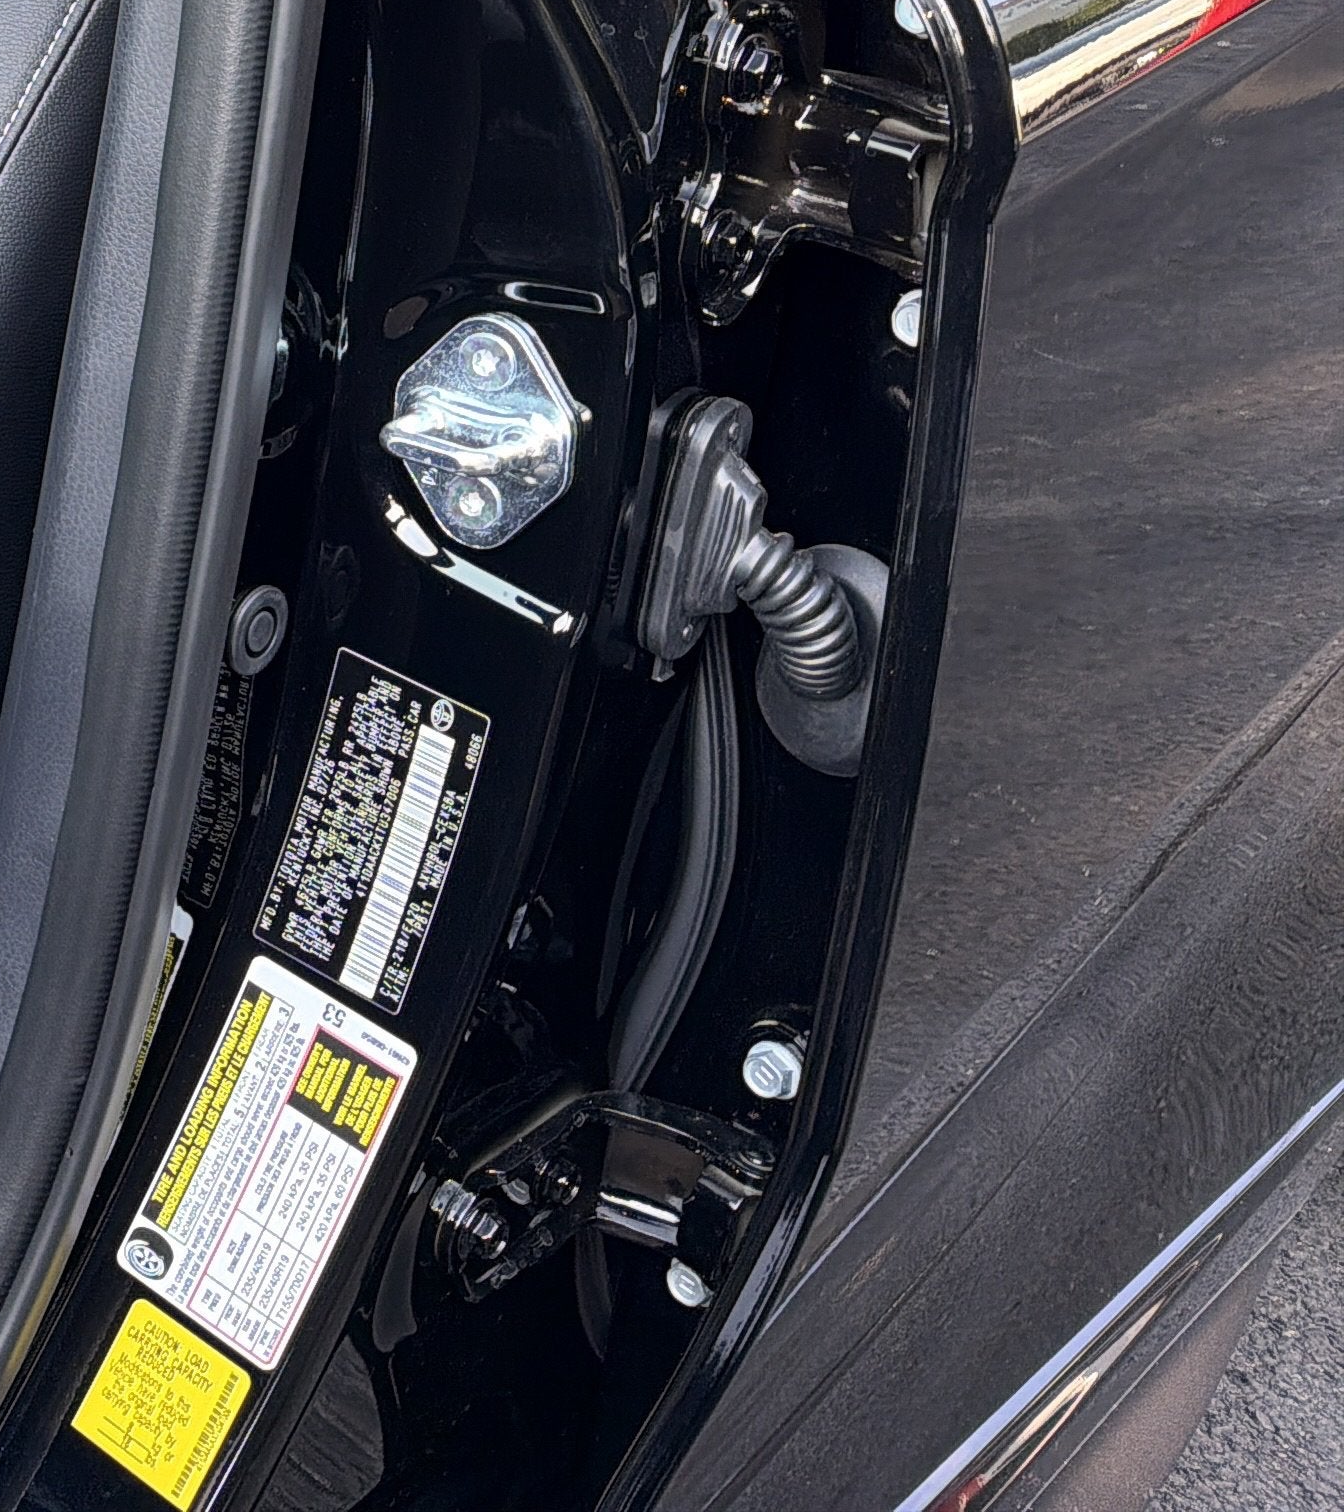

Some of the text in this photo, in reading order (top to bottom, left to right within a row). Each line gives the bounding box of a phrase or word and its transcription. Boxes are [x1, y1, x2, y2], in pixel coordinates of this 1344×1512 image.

[352, 674, 384, 746] APPLICABLE
[346, 751, 361, 773] ALL
[373, 757, 394, 795] SHOWN
[462, 732, 484, 771] 48066
[280, 909, 299, 943] GVWR
[310, 827, 328, 859] GAWR
[320, 806, 334, 824] FR
[341, 738, 355, 756] RR
[293, 793, 313, 834] MOTOR
[300, 901, 325, 953] FEDERAL
[319, 858, 341, 898] MOTOR
[334, 803, 358, 855] VEHICLE
[377, 679, 393, 704] AND
[309, 918, 329, 957] THEFT
[324, 841, 356, 917] PREVENTION
[349, 773, 379, 840] STANDARDS
[374, 705, 397, 749] EFFECT
[388, 684, 402, 702] ON
[321, 797, 348, 857] CONFORMS
[347, 799, 381, 880] MANUFACTURE
[428, 856, 447, 889] MADE
[446, 787, 469, 832] U.S.A.
[302, 859, 328, 913] VEHICLE
[341, 883, 354, 901] OF
[291, 914, 310, 947] THIS
[328, 903, 348, 937] DATE
[318, 938, 335, 963] THE
[151, 998, 253, 1206] TIRE AND LOADING INFORMATION
[155, 991, 272, 1229] RENSEIGNEMENTS SUR LES PNEUS ET LE CHARGEMENT
[315, 1170, 328, 1187] 35
[321, 1151, 337, 1173] PSI
[240, 1240, 272, 1297] 235/40R19
[277, 1197, 293, 1219] 240
[297, 1159, 310, 1176] 35
[304, 1140, 319, 1161] PSI
[275, 1258, 310, 1322] T155/70D17
[313, 1221, 329, 1244] 420
[333, 1182, 346, 1199] 60
[340, 1162, 355, 1184] PSI
[295, 1209, 311, 1232] 240
[258, 1252, 289, 1310] 235/40R19
[125, 1324, 213, 1395] CARRYING CAPACITY
[134, 1345, 176, 1383] REDUCED
[183, 1348, 210, 1375] LOAD
